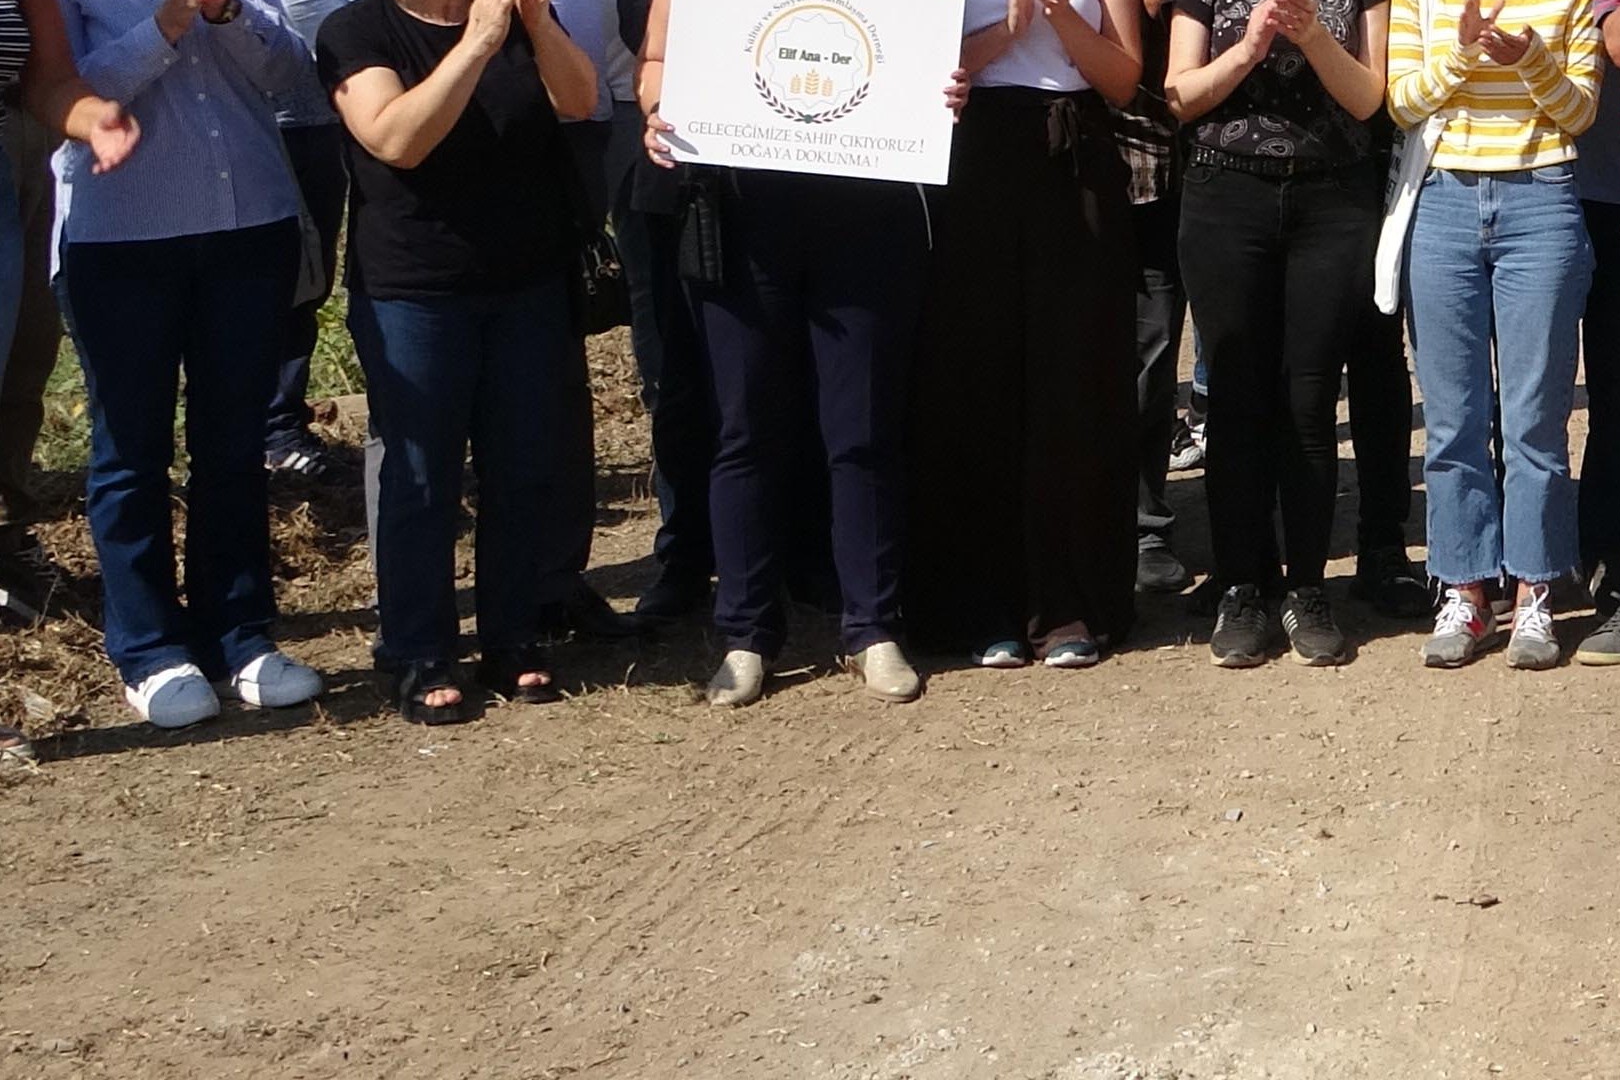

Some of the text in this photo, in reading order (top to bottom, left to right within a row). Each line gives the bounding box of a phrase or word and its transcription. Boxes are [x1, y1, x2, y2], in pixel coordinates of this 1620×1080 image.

[778, 47, 798, 60] Elif
[799, 50, 821, 62] Ana
[831, 52, 853, 65] Der
[688, 120, 792, 142] GELECEĞİMİZE
[731, 143, 793, 161] DOĞAYA
[796, 148, 871, 167] DOKUNMA
